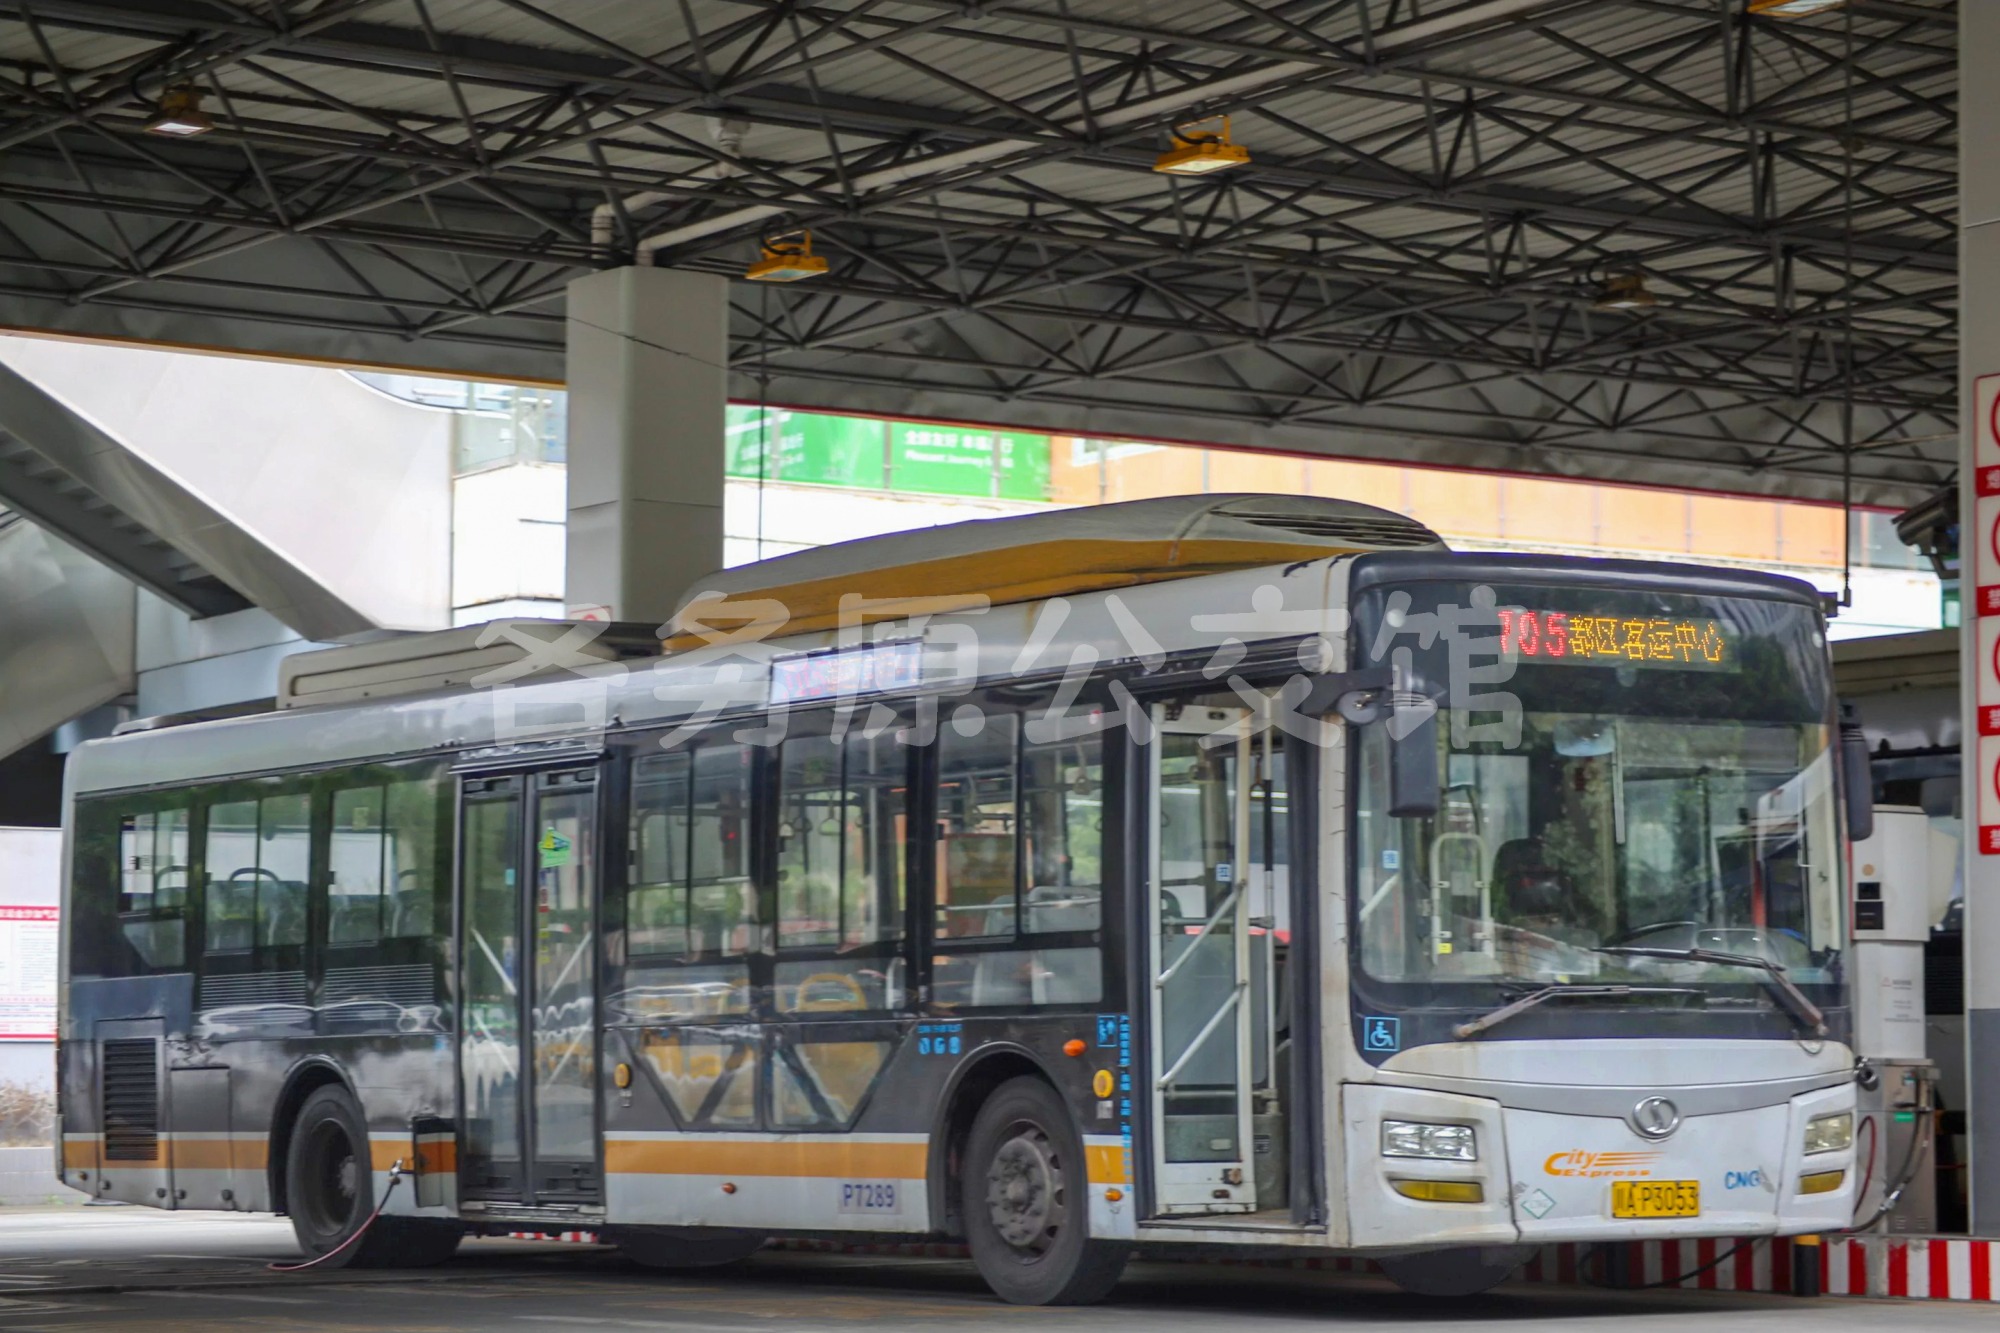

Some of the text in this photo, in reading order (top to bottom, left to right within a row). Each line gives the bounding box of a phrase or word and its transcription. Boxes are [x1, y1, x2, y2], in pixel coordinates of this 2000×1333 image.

[1498, 610, 1724, 662] 705 都区客运中心
[1543, 1148, 1597, 1176] City
[1561, 1168, 1650, 1178] Express
[1724, 1168, 1761, 1190] CNG
[842, 1183, 896, 1208] P7289
